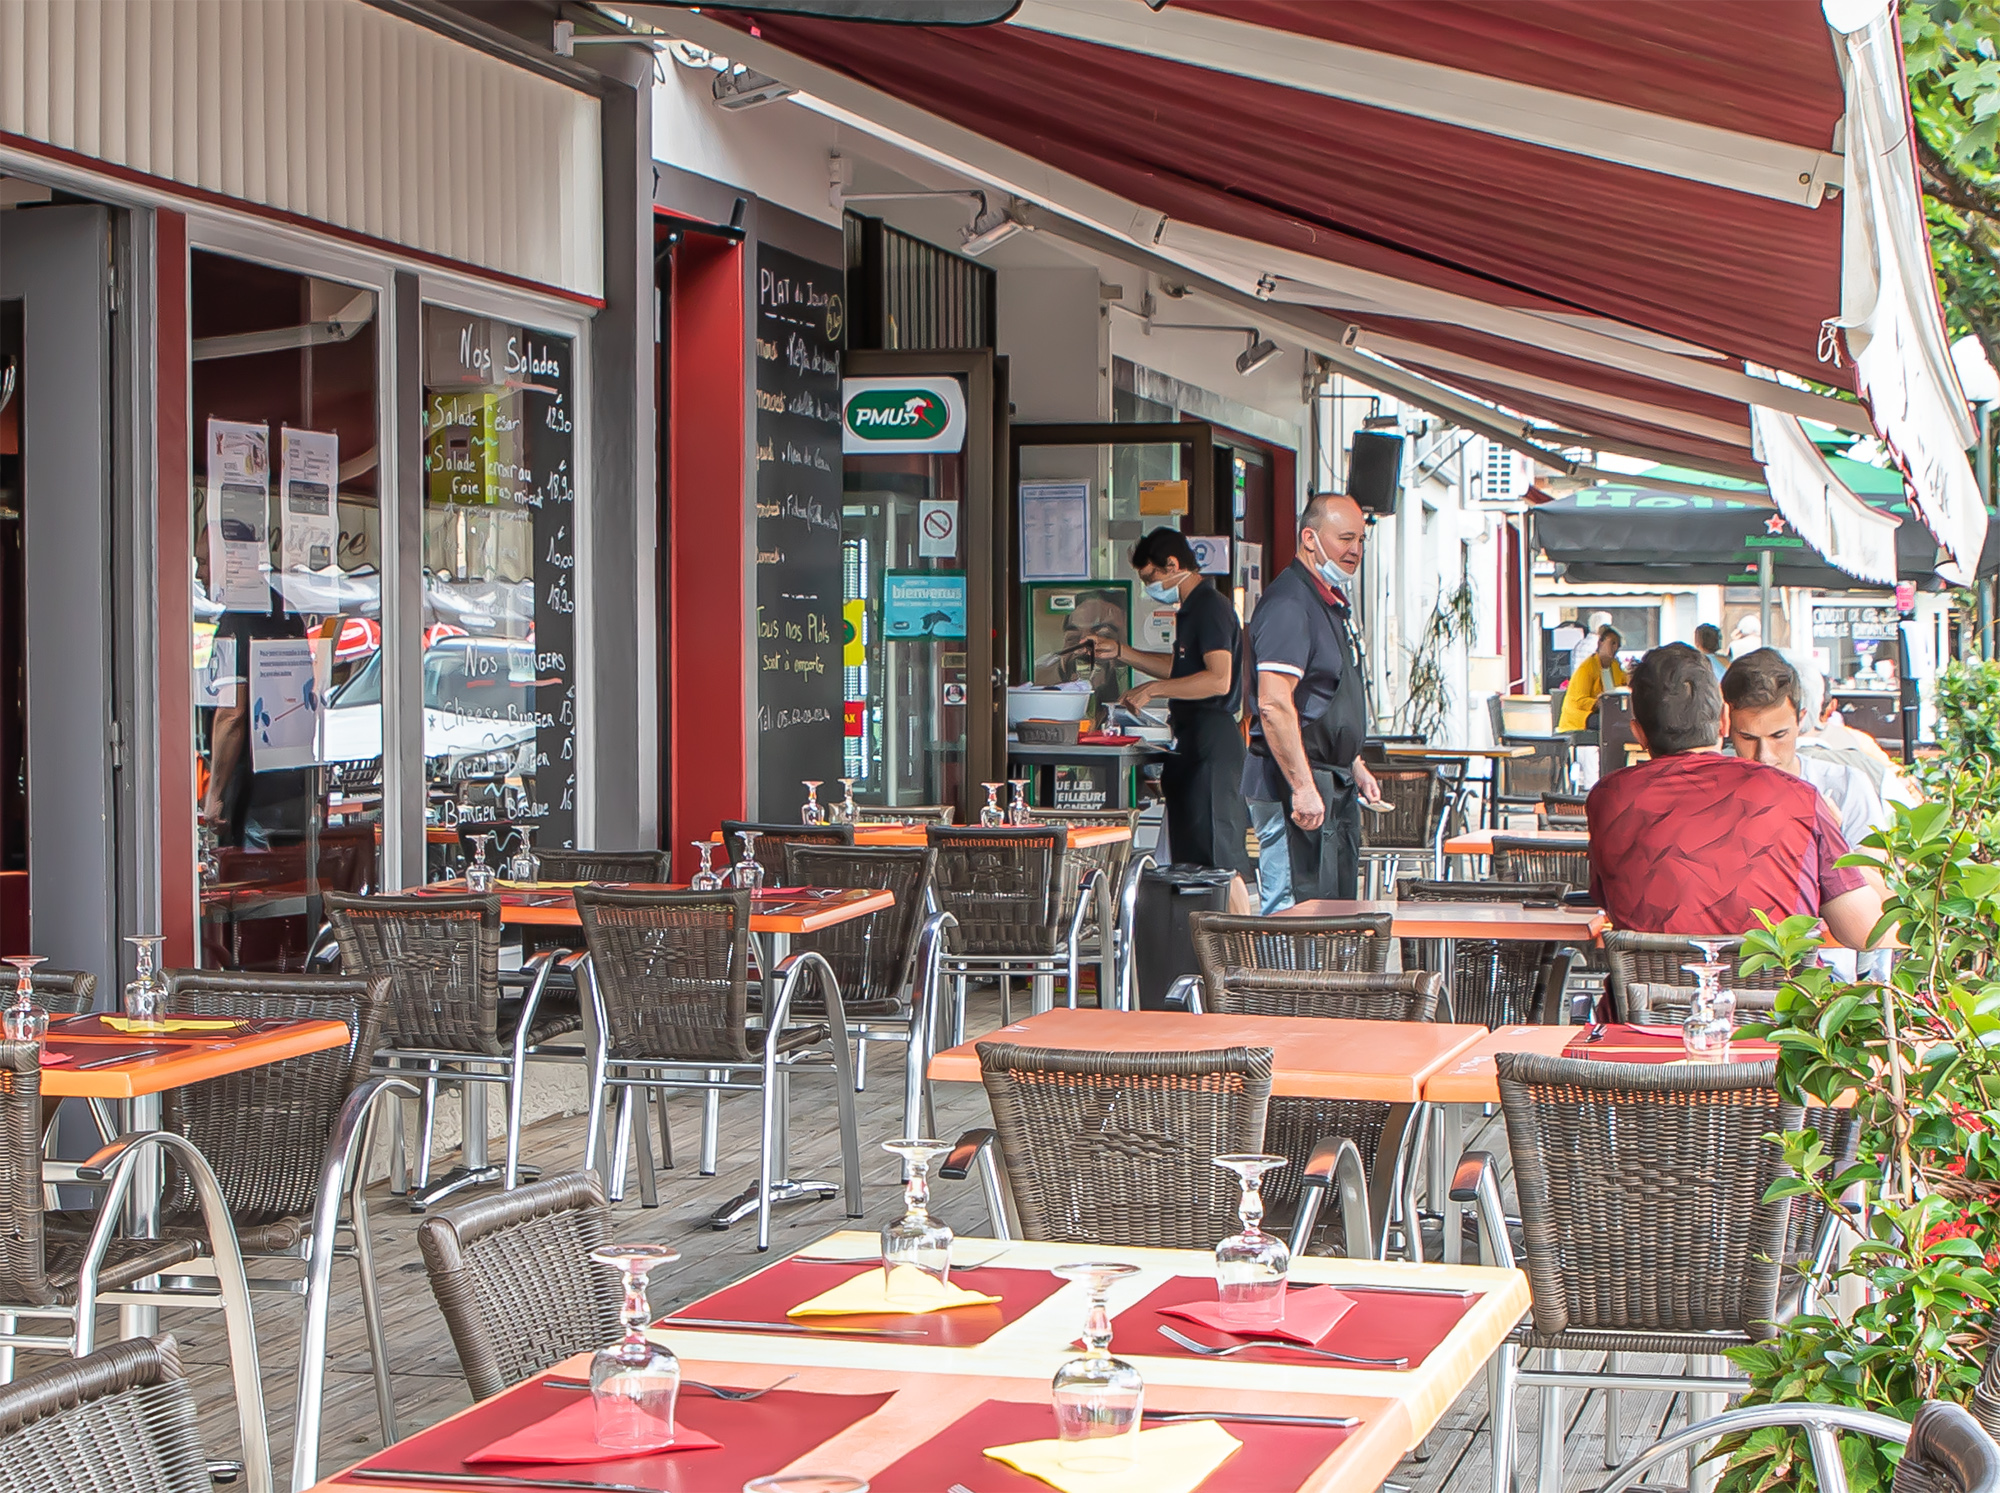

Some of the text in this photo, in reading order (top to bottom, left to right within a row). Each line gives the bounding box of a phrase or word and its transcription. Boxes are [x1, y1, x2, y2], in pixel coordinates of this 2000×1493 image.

[761, 268, 790, 307] PLAT
[460, 324, 560, 379] Nos Salades
[432, 397, 572, 432] Salade César 12,90
[855, 408, 904, 427] PMU
[433, 445, 477, 473] Salade
[518, 467, 532, 483] au
[547, 471, 574, 503] 18,90
[892, 584, 962, 599] bienvenus
[757, 606, 830, 644] Tous nos Plats
[464, 644, 498, 677] Nos
[442, 696, 499, 731] Cheese
[1056, 781, 1070, 790] UE
